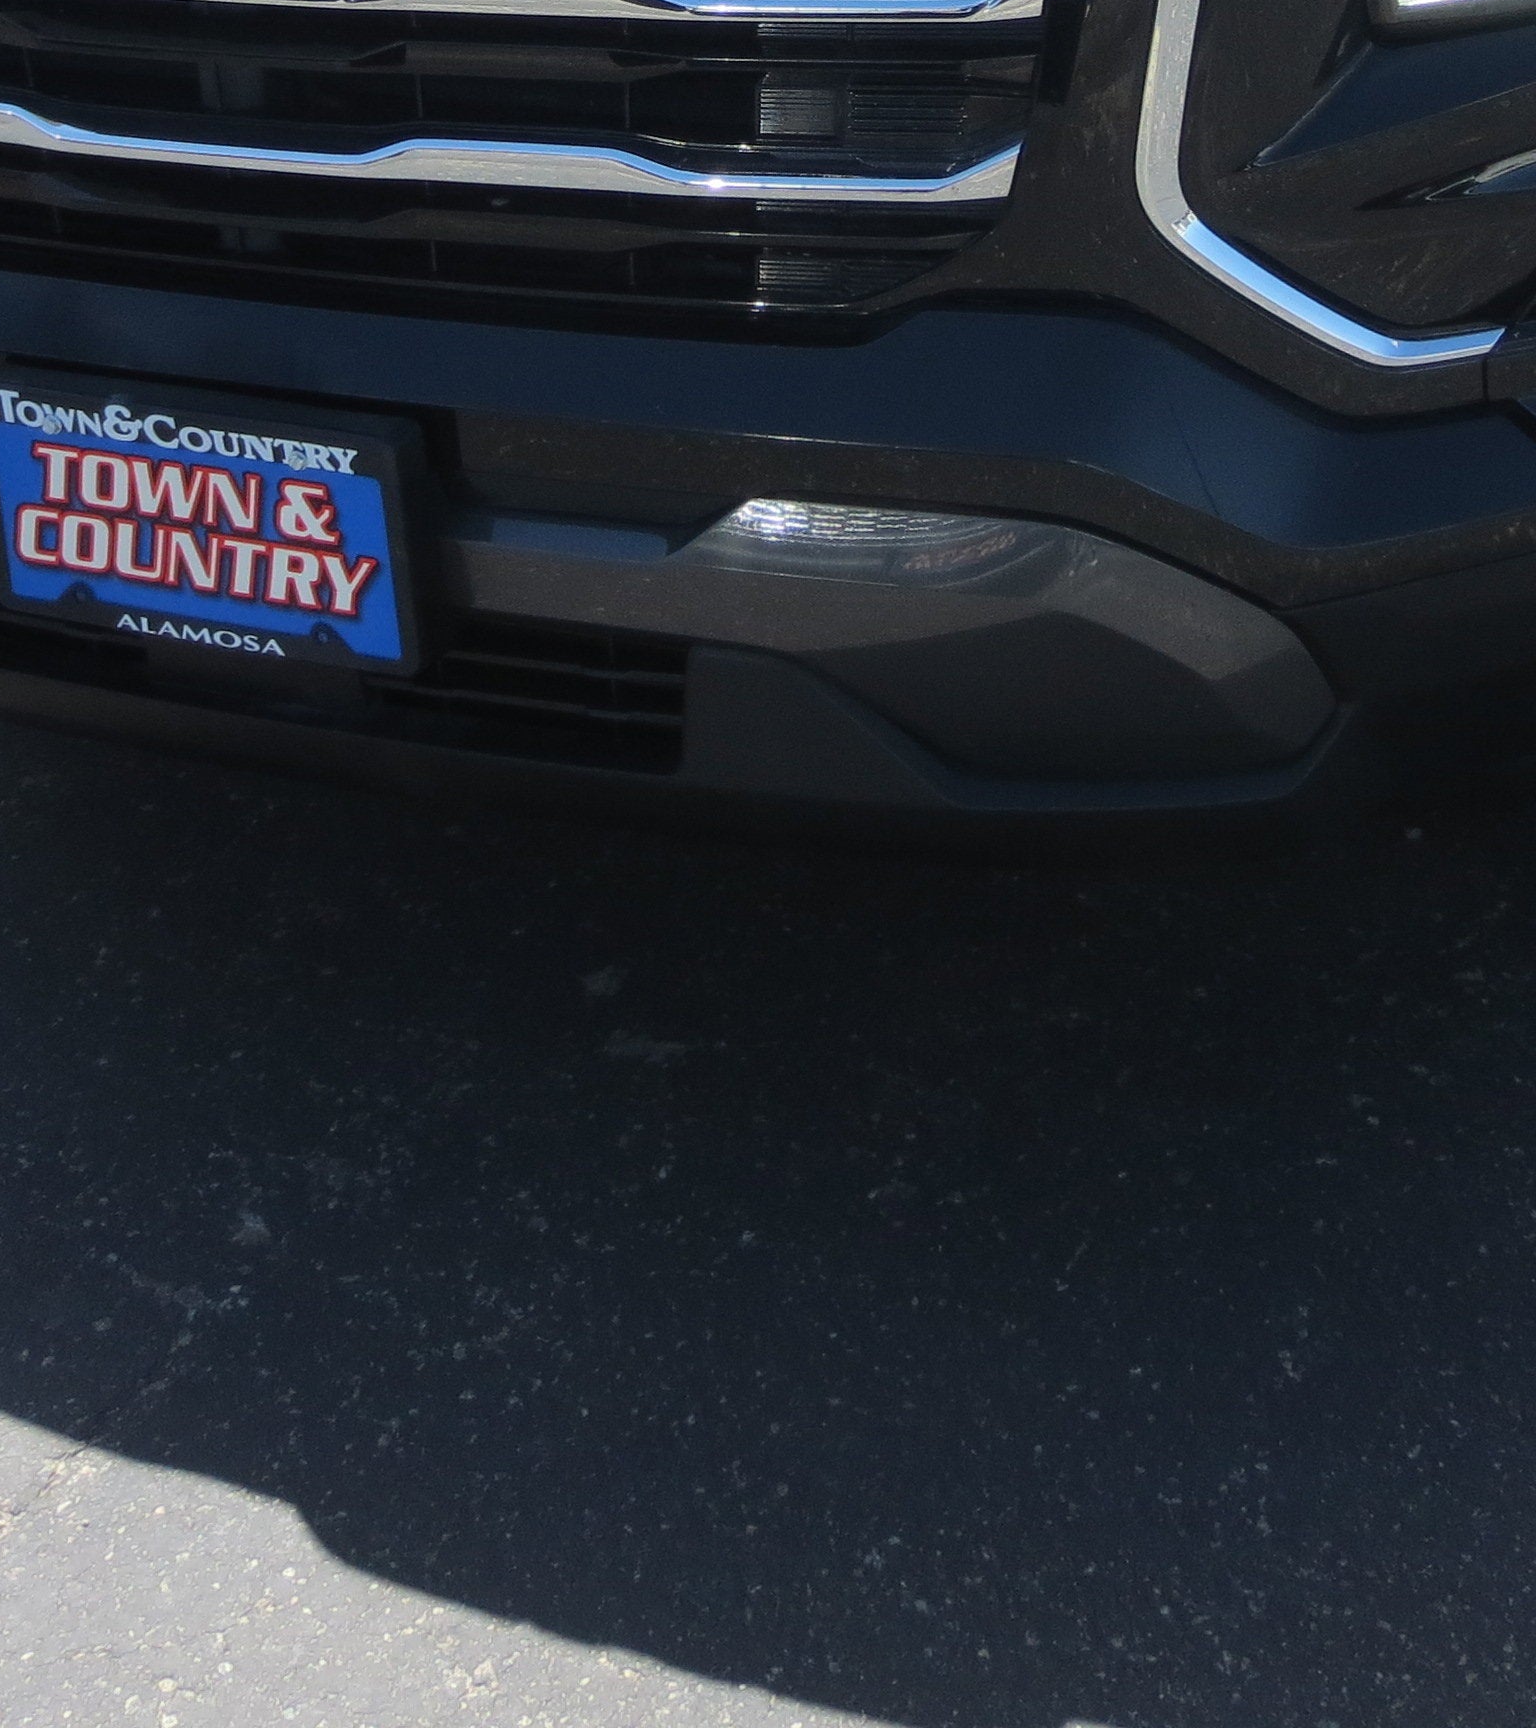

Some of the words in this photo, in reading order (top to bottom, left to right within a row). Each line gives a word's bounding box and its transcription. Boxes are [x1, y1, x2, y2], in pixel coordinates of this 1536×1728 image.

[31, 441, 261, 534] TOWN
[274, 478, 340, 546] &
[15, 503, 378, 618] COUNTRY
[116, 613, 286, 657] ALAMOSA
